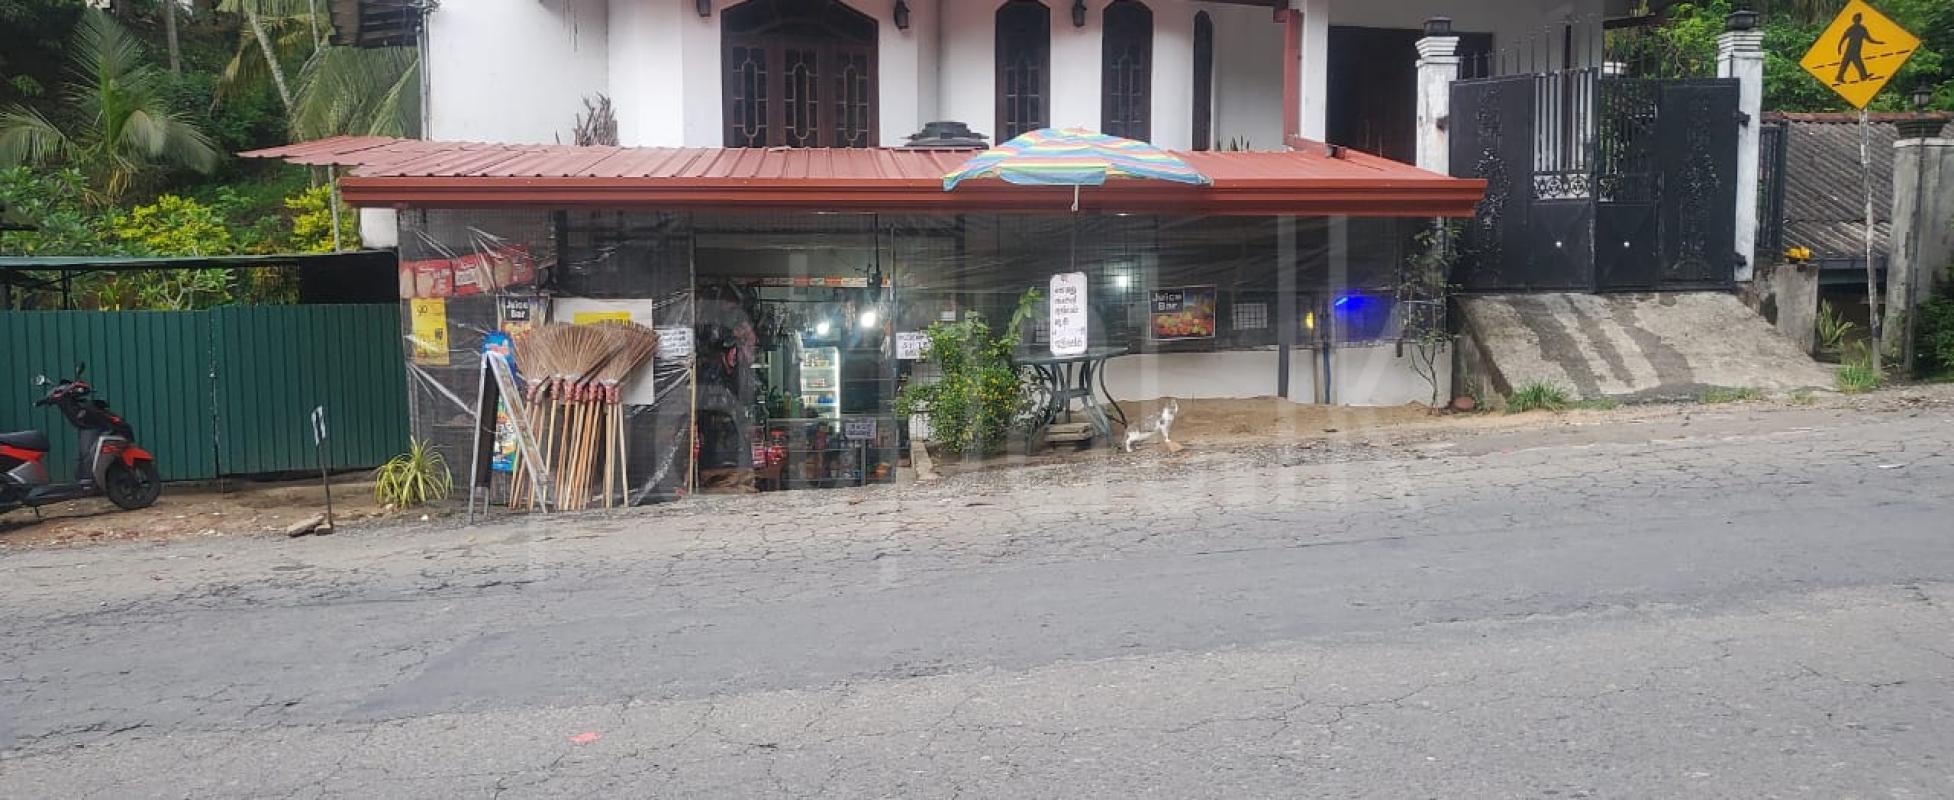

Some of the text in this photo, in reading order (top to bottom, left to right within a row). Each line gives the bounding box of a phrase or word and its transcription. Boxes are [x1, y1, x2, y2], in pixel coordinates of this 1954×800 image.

[1151, 292, 1182, 302] Juice
[506, 299, 529, 310] Juice
[1158, 302, 1178, 311] Bar
[510, 309, 526, 319] Bar
